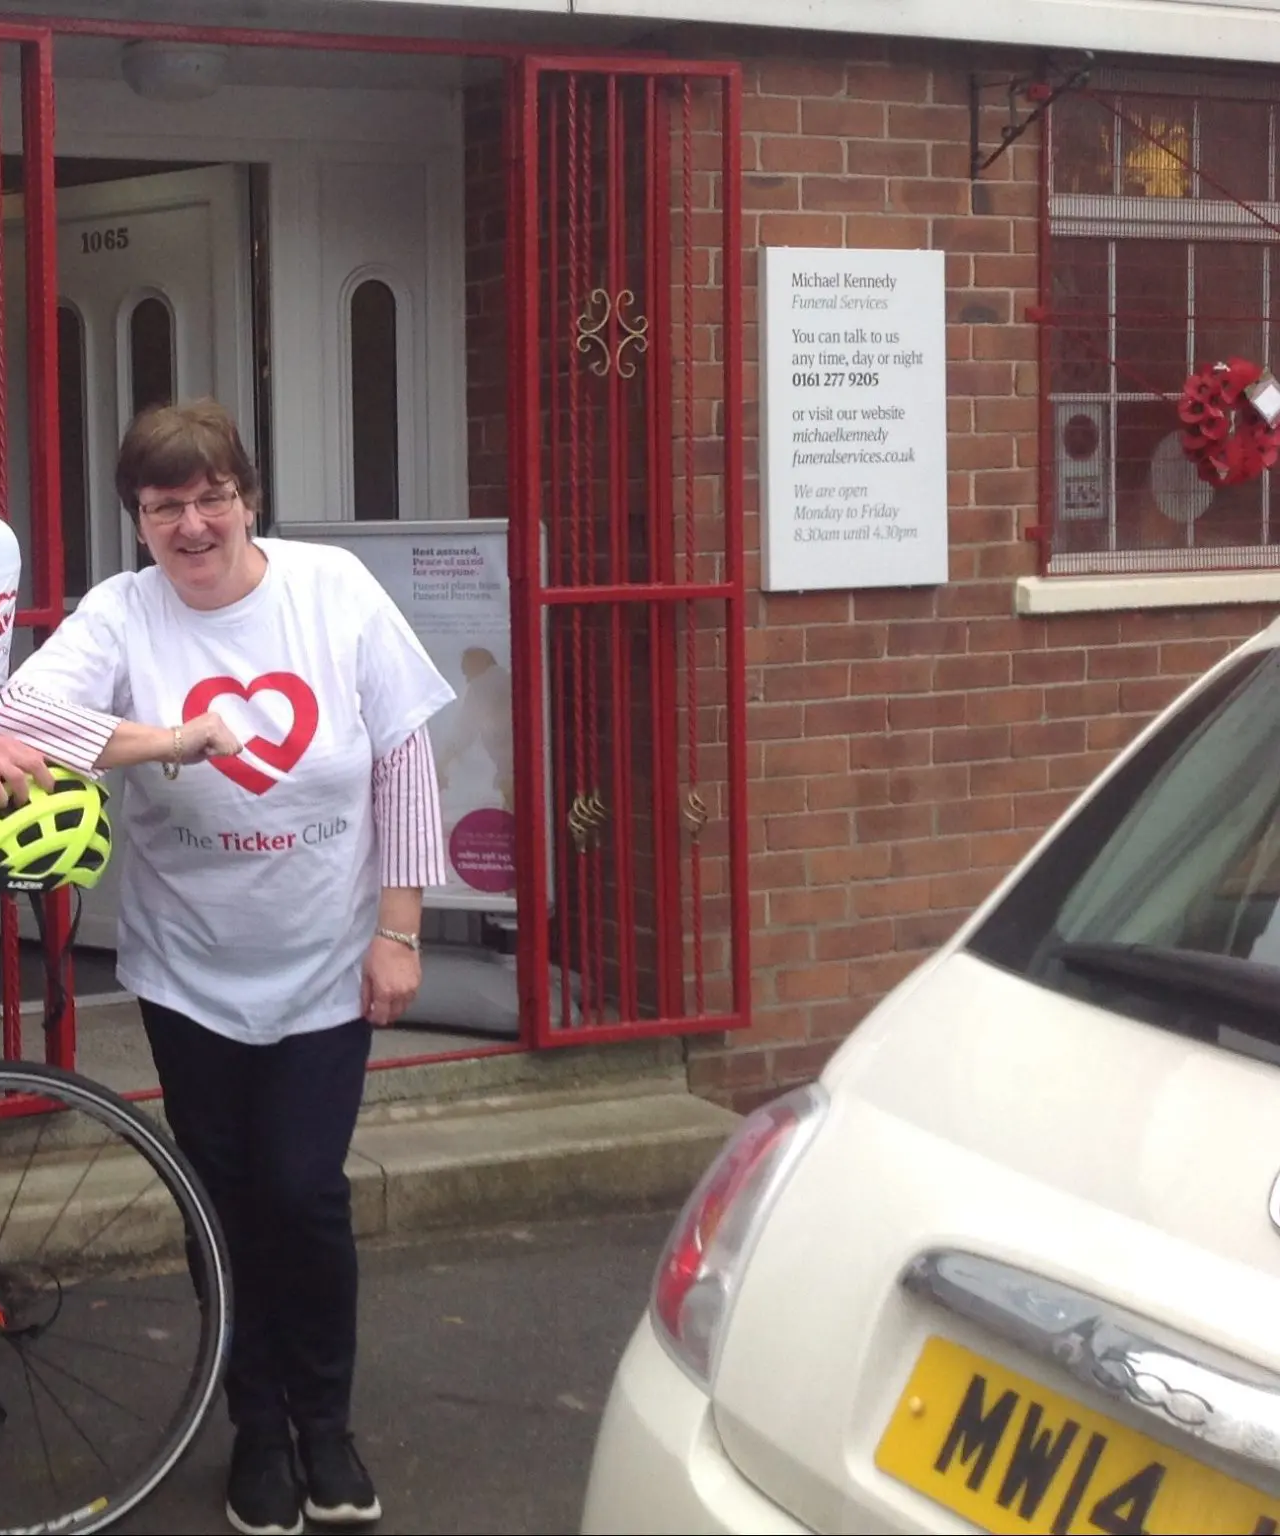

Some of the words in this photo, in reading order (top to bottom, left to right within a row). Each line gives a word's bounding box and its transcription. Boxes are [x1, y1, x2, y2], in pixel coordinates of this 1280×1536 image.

[81, 228, 128, 253] 1065
[792, 272, 840, 289] Michael
[843, 273, 897, 291] Kennedy
[792, 294, 837, 310] Funeral
[839, 295, 888, 311] Services
[792, 328, 815, 344] You
[818, 331, 841, 344] can
[844, 328, 867, 344] talk
[870, 330, 882, 344] to
[885, 332, 900, 344] us
[792, 353, 815, 369] any
[818, 350, 849, 367] time,
[852, 350, 874, 368] day
[877, 353, 890, 366] or
[893, 351, 923, 369] night
[792, 372, 820, 388] 0161
[823, 372, 846, 387] 277
[848, 372, 879, 388] 9205
[792, 408, 805, 421] or
[808, 405, 833, 421] visit
[836, 408, 858, 421] our
[860, 405, 906, 421] website
[792, 427, 889, 446] michaelkennedy
[792, 448, 916, 467] funeralservices.co.uk
[794, 484, 813, 498] We
[816, 486, 836, 499] are
[838, 485, 868, 501] open
[794, 504, 843, 521] Monday
[846, 506, 858, 519] to
[861, 503, 900, 521] Friday
[794, 527, 841, 543] 8.30am
[843, 525, 870, 541] until
[872, 524, 918, 543] 4.30pm
[173, 825, 213, 850] The
[217, 831, 297, 851] Ticker
[301, 816, 348, 846] Club
[7, 880, 44, 890] LAZER
[933, 1372, 1168, 1535] MW14
